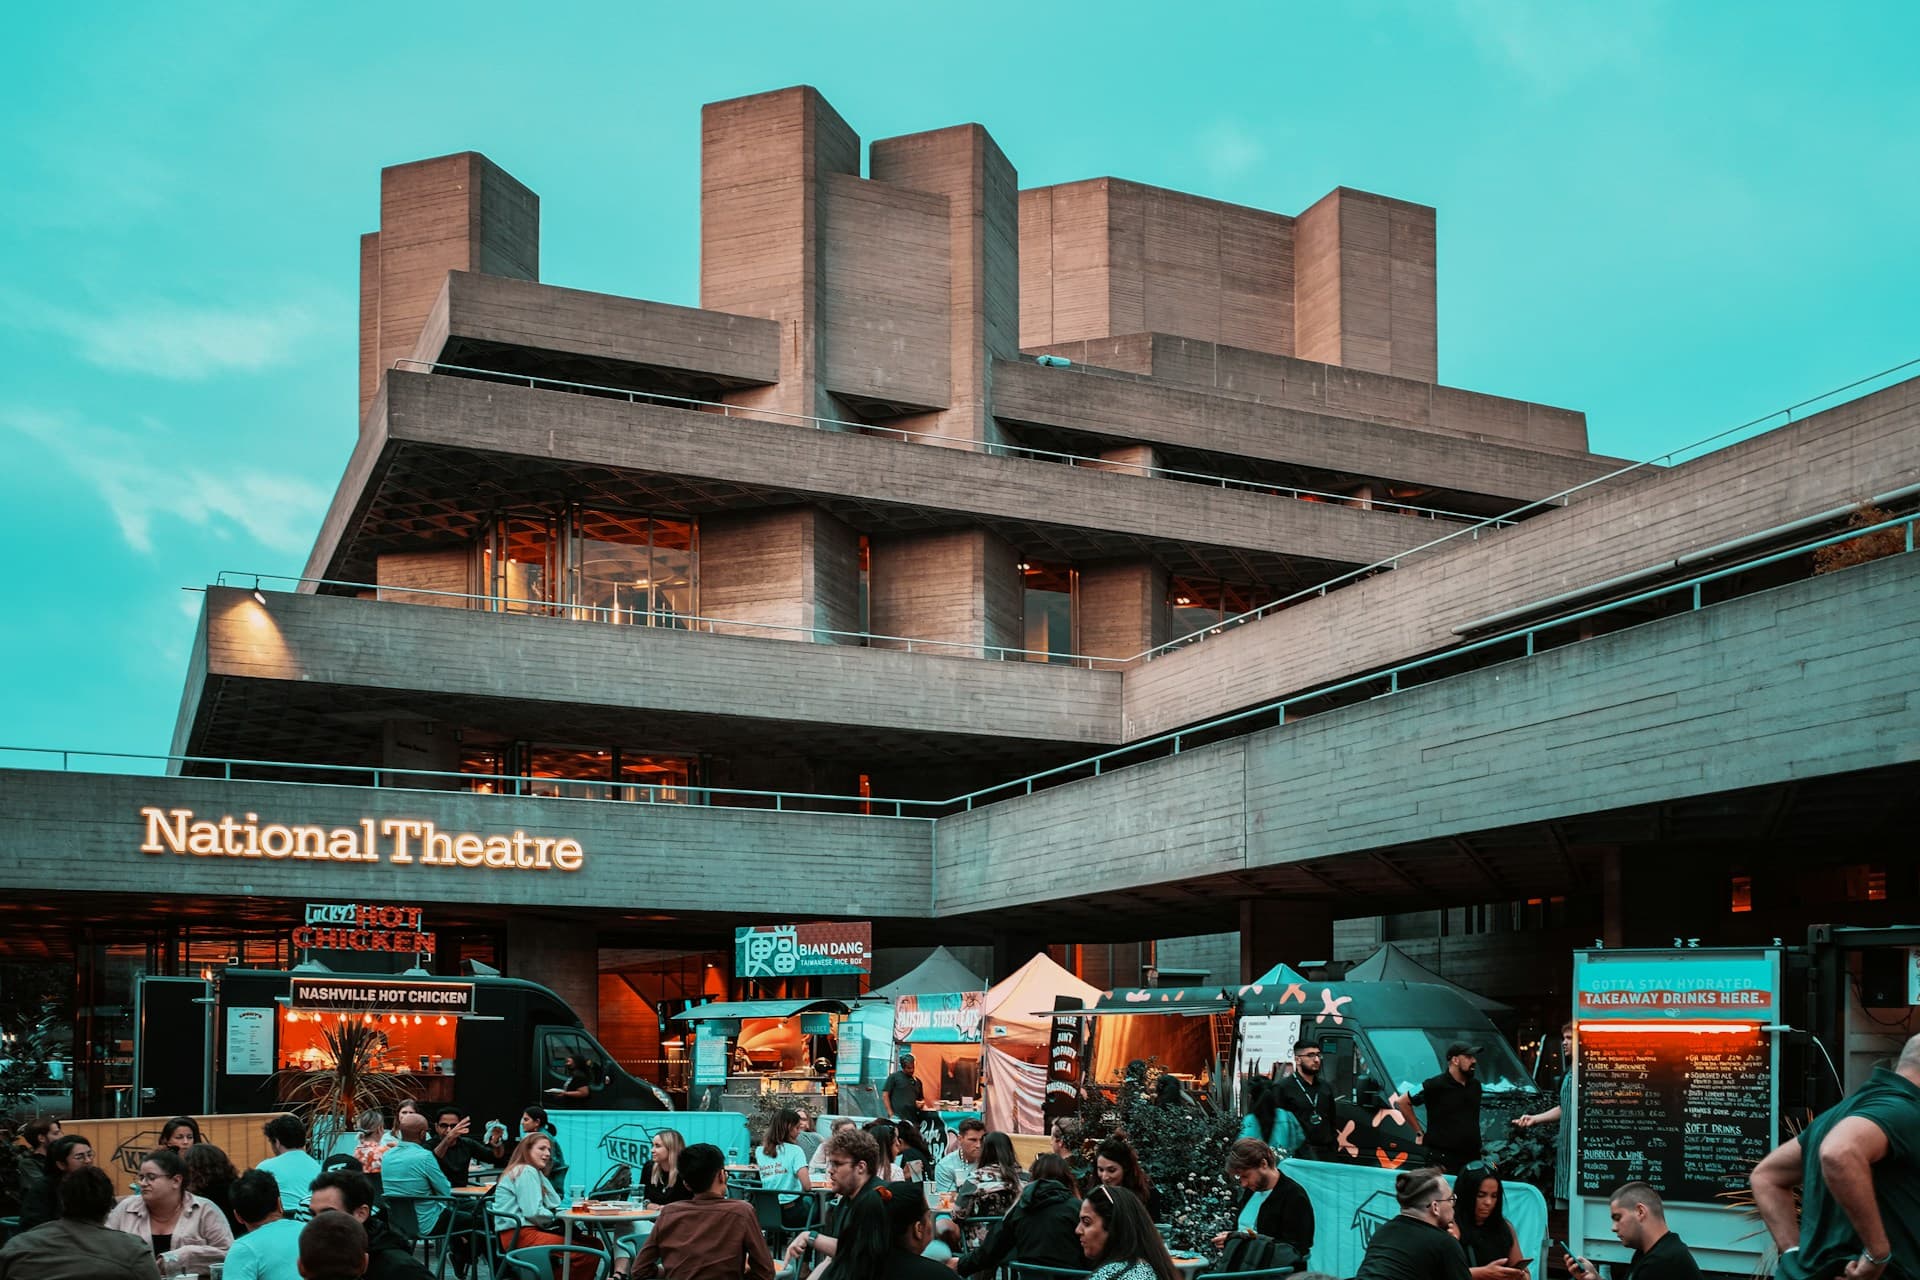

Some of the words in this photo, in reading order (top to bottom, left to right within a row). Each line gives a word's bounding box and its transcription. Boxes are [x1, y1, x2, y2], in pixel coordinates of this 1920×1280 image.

[141, 807, 379, 863] National
[383, 819, 583, 870] Theatre
[356, 905, 422, 928] HOT
[292, 926, 435, 953] CHICKEN
[800, 943, 828, 956] BIAN
[830, 941, 863, 955] DANG
[800, 958, 832, 966] TAIWANESE
[850, 957, 862, 965] BOX
[1592, 978, 1634, 991] GOTTA
[1640, 978, 1672, 990] STAY
[1678, 978, 1757, 990] HYDRATED.
[299, 986, 376, 1001] NASHVILLE
[379, 989, 406, 1002] HOT
[408, 990, 467, 1004] CHICKEN
[1585, 992, 1659, 1004] TAKEAWAY
[1663, 992, 1716, 1004] DRINKS
[1721, 992, 1764, 1004] HERE.
[1057, 1016, 1077, 1027] THERE
[1052, 1047, 1060, 1058] NO
[1060, 1045, 1077, 1059] PARTY
[1054, 1060, 1066, 1072] LIKE
[1684, 1122, 1708, 1134] SOFT
[1711, 1123, 1742, 1135] DRINKS
[608, 1139, 651, 1166] KERB
[1583, 1149, 1615, 1160] BUBBLES
